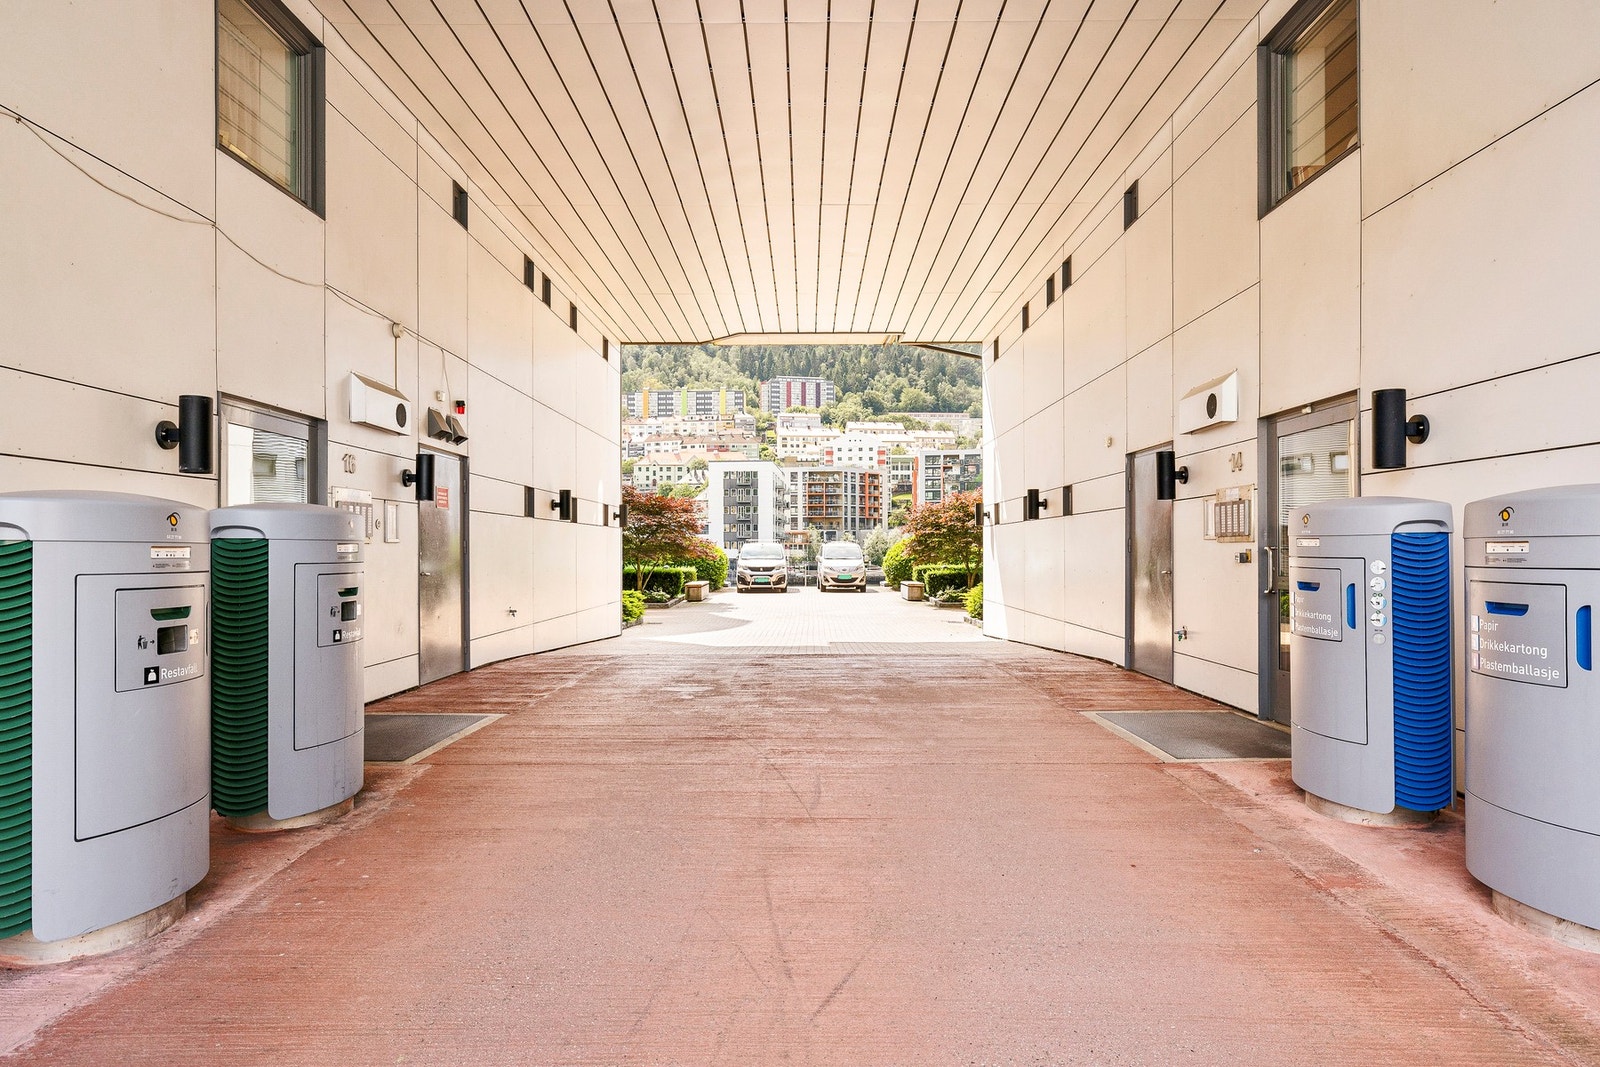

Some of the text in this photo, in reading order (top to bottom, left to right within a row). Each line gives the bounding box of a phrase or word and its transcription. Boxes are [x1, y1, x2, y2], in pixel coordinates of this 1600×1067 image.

[341, 453, 356, 474] 16
[1229, 452, 1243, 472] 14
[1479, 618, 1499, 633] Papir
[1479, 639, 1548, 659] Drikkekartong
[161, 663, 198, 680] Restavfall
[1479, 656, 1560, 681] Plastemballasje
